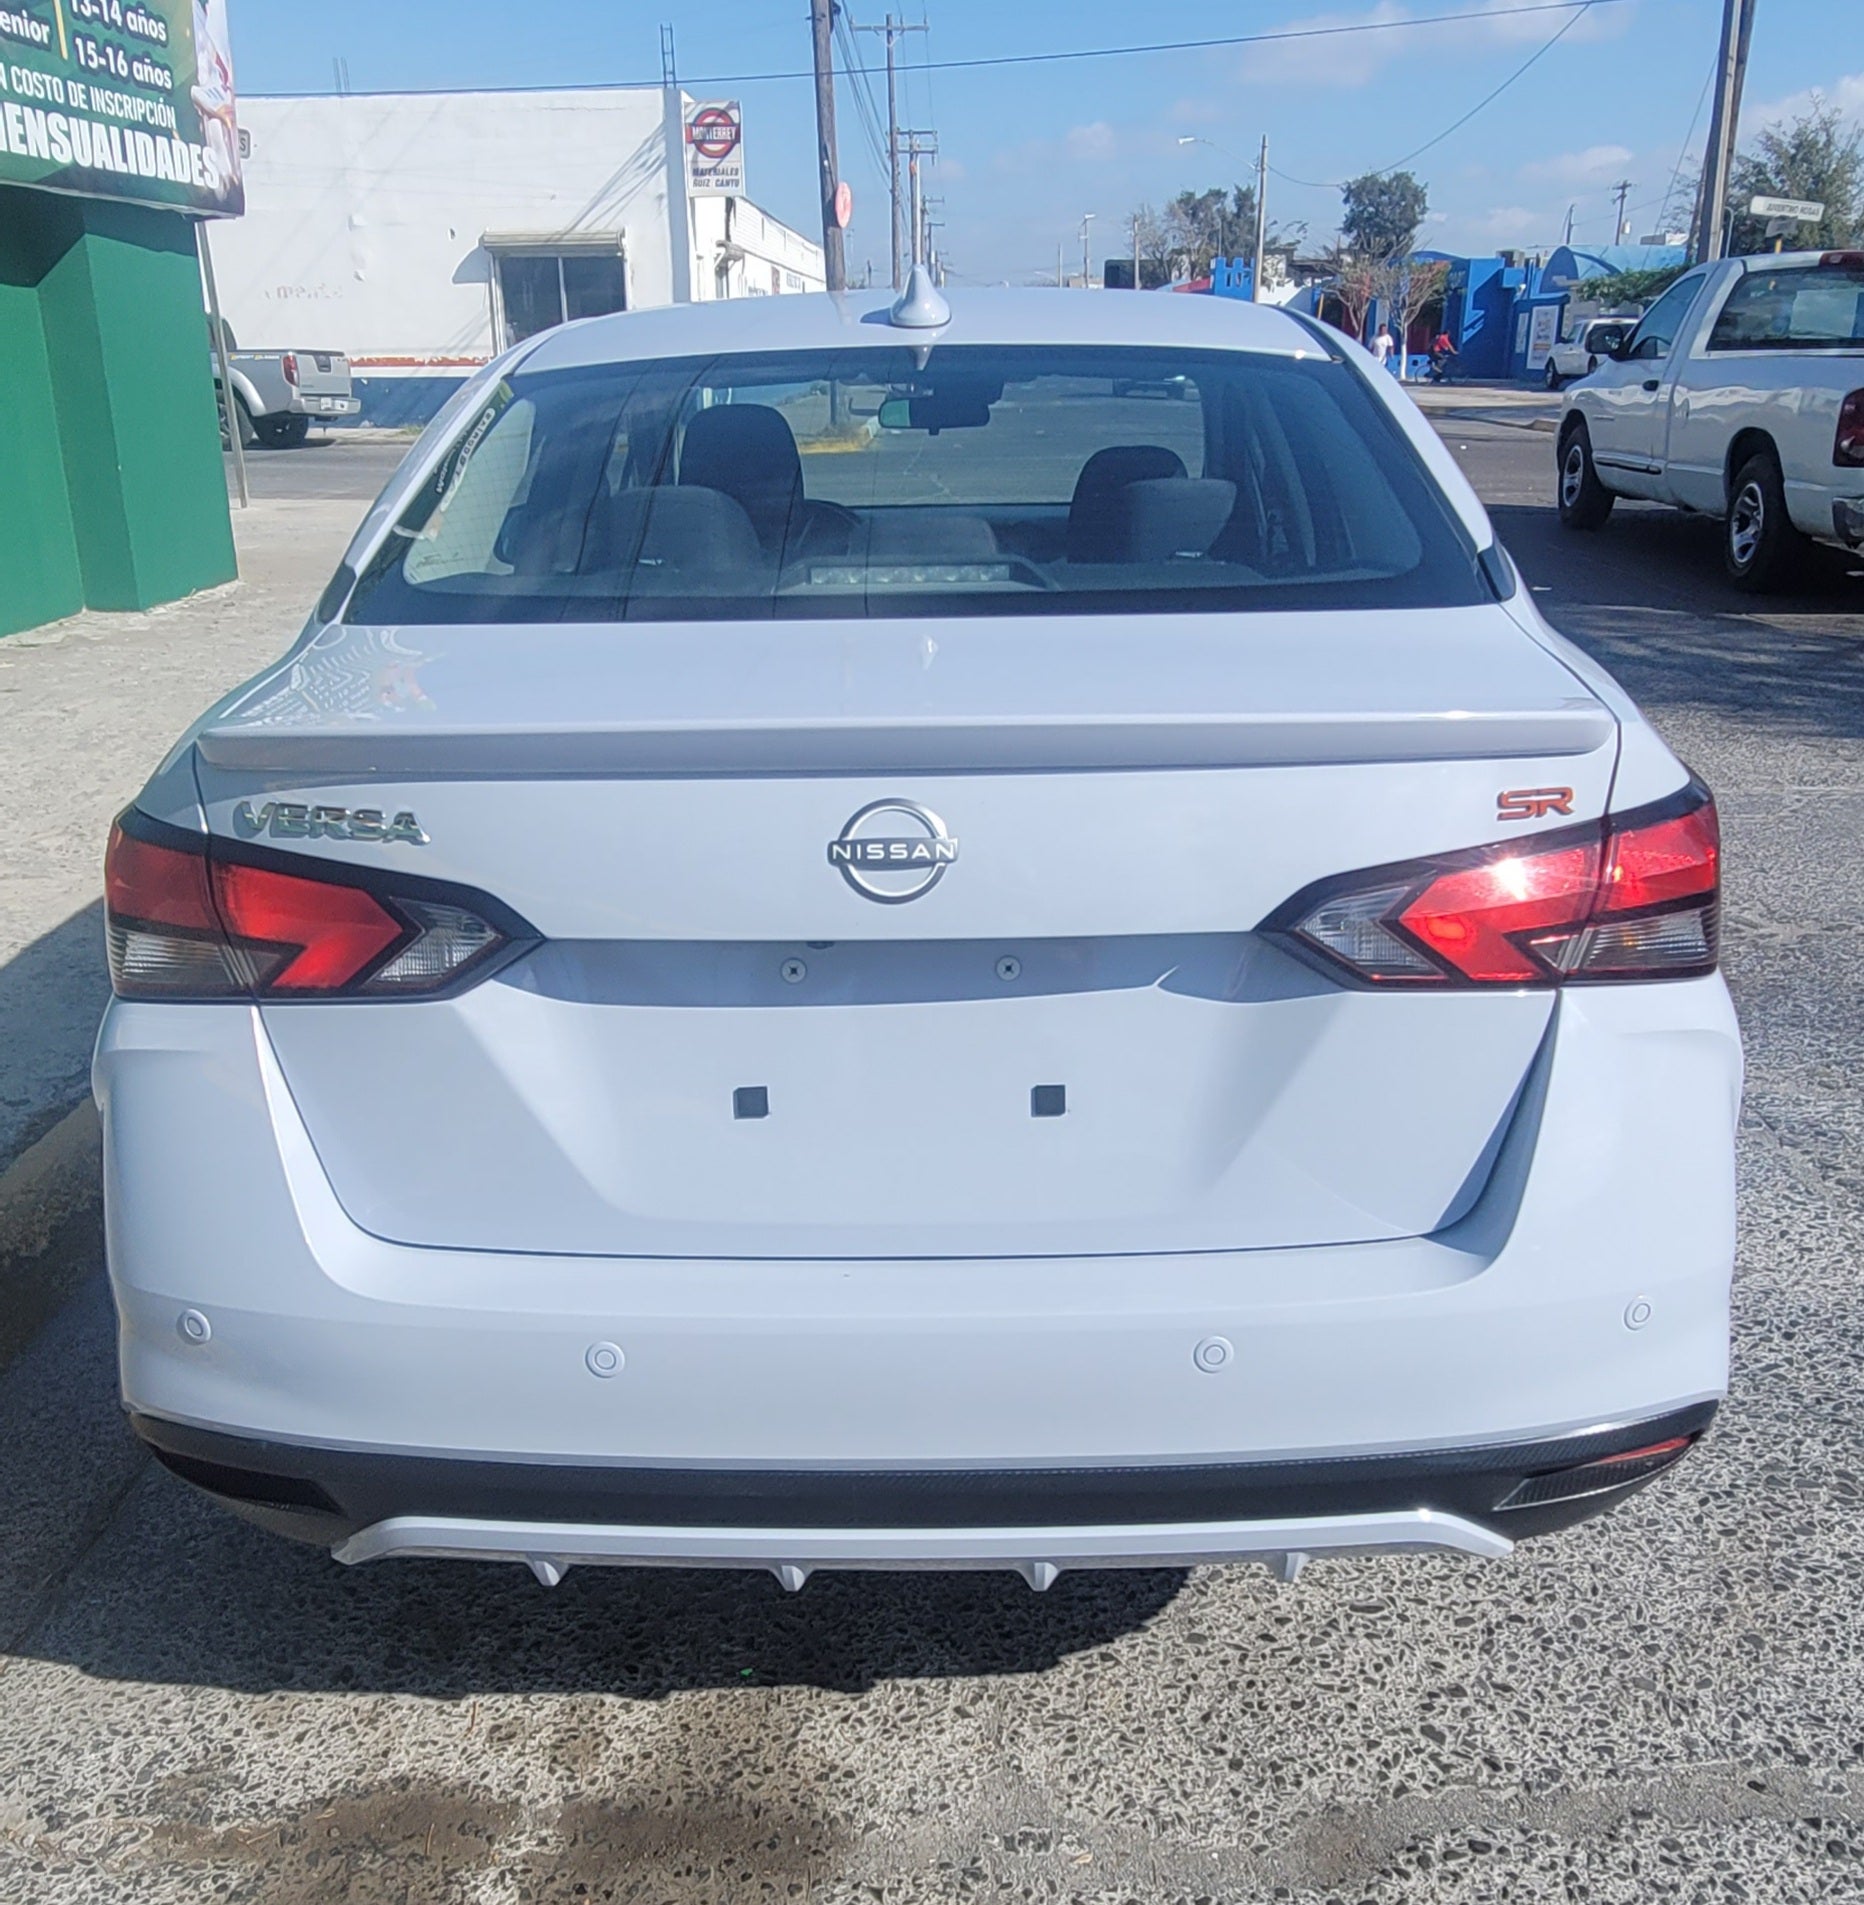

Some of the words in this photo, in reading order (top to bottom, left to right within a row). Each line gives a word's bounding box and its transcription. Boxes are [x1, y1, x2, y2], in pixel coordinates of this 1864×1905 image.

[126, 8, 167, 42] años
[75, 37, 128, 78] 15-16
[132, 57, 172, 90] años
[10, 65, 65, 104] COSTO
[66, 80, 89, 110] DE
[89, 86, 177, 130] INSCRIPCIÓN
[691, 126, 737, 140] MONTERREY
[1496, 787, 1575, 821] SR
[234, 801, 431, 846] VERSA
[832, 843, 955, 860] NISSAN
